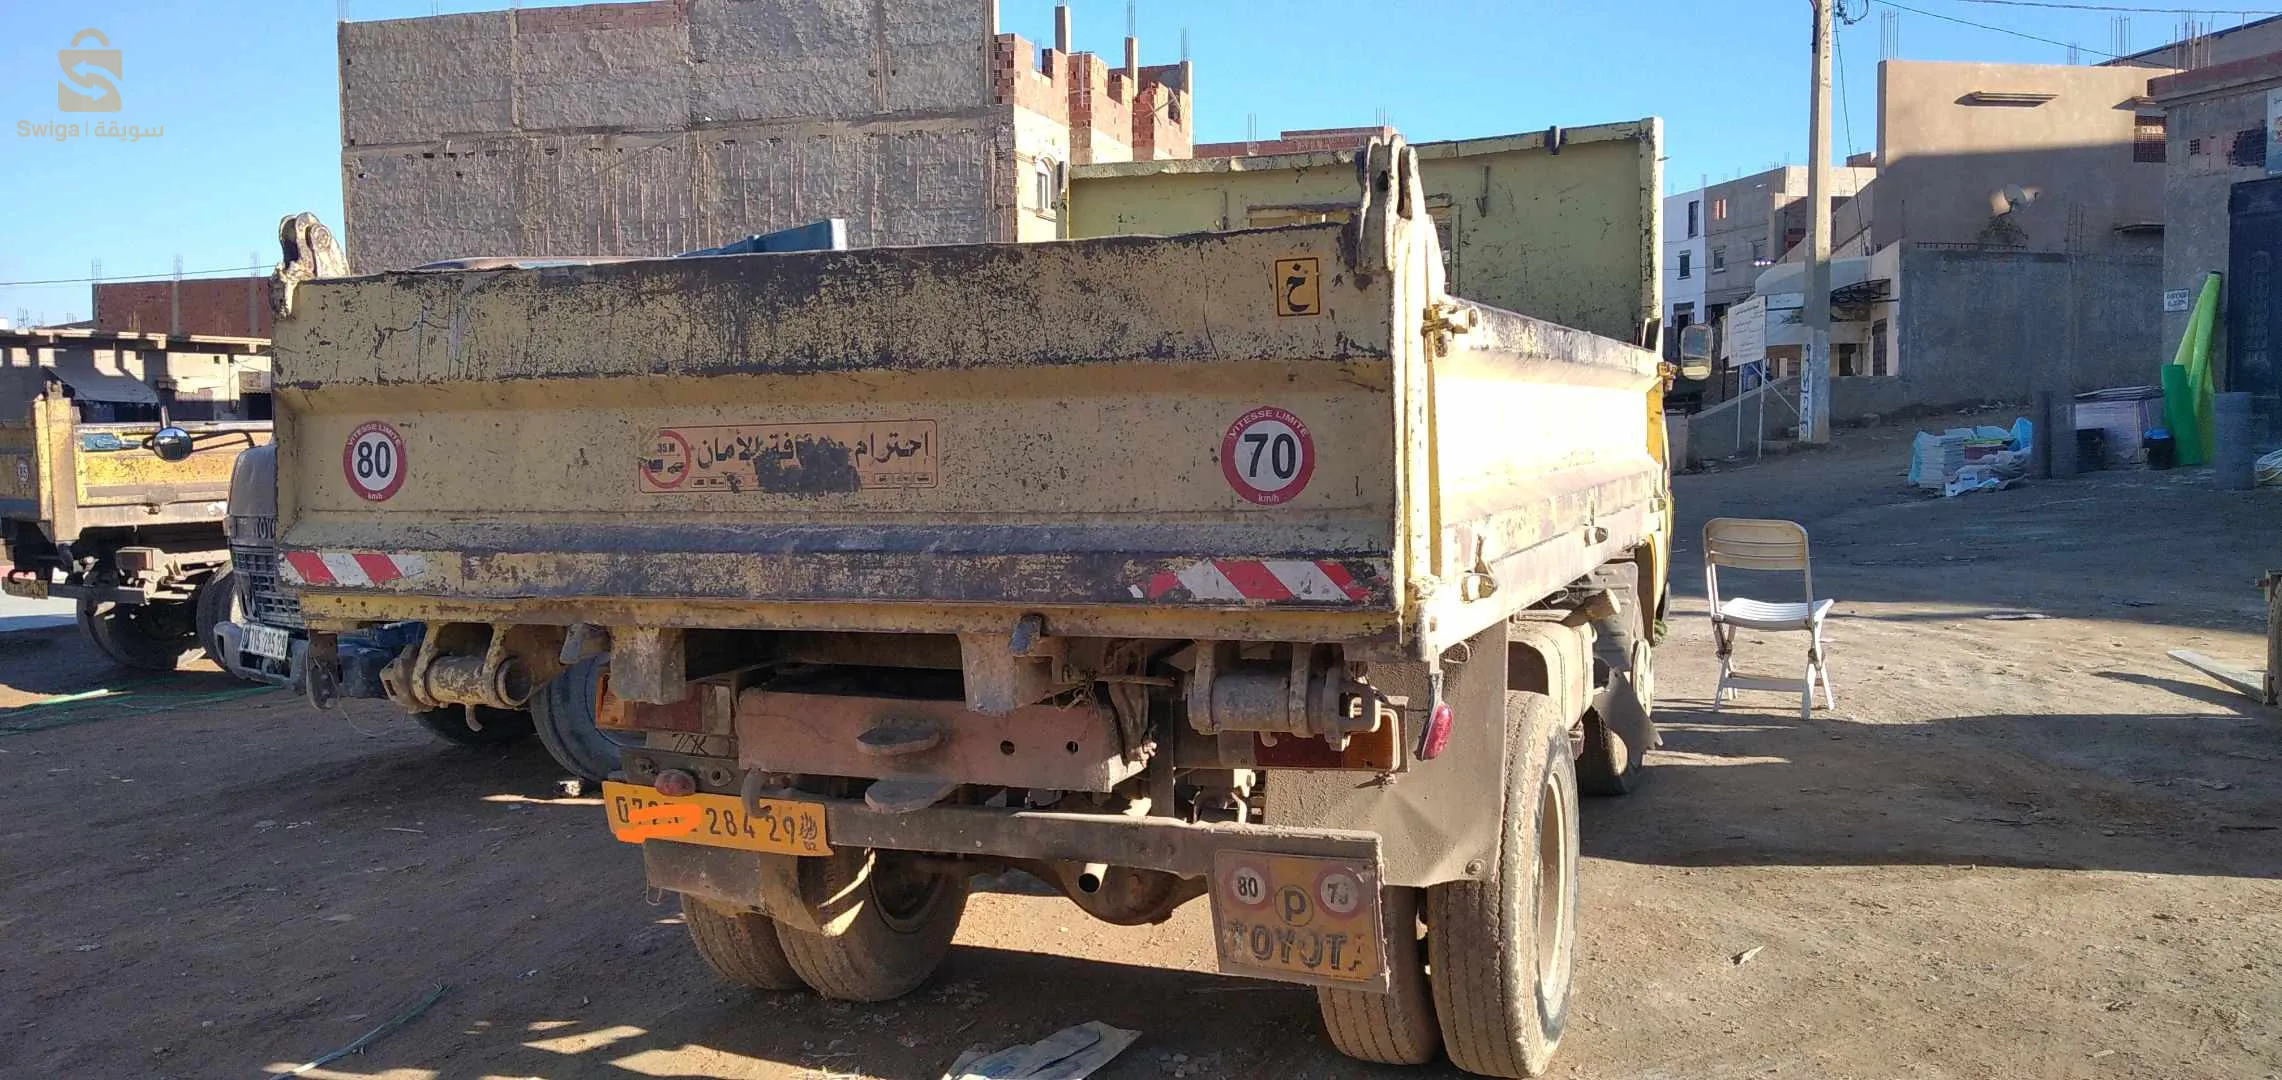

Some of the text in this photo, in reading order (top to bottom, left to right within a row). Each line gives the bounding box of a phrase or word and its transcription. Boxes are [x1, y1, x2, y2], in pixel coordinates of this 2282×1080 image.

[1286, 263, 1310, 312] خ
[1228, 409, 1309, 439] VITESSE LIMITE
[357, 441, 391, 478] 80
[855, 431, 929, 467] احترام
[1244, 433, 1296, 479] 70
[705, 807, 756, 838] 284
[765, 805, 796, 843] 29
[1238, 876, 1258, 898] 80
[1284, 889, 1306, 922] P
